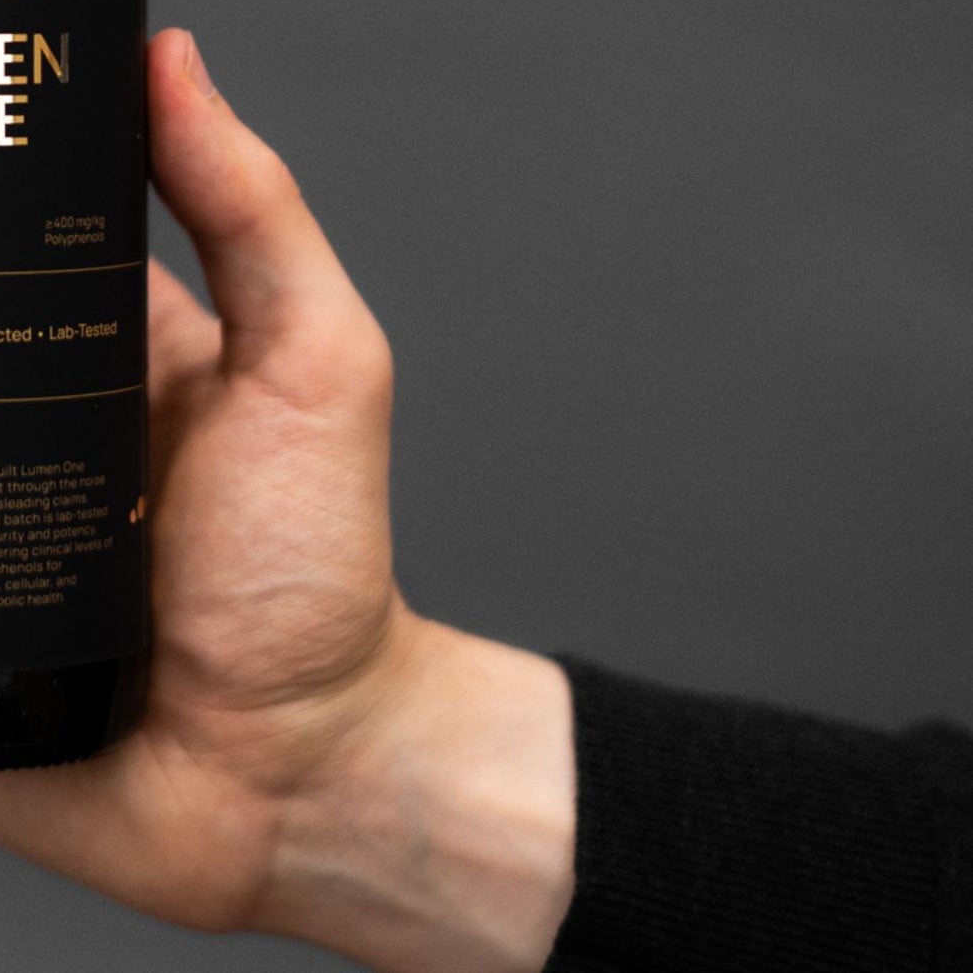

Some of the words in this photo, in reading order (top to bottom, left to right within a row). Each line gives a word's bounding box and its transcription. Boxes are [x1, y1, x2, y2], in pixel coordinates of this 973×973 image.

[76, 215, 106, 230] mg/kg
[45, 231, 105, 247] Polyphenols
[49, 321, 117, 341] Lab-Tested
[21, 463, 60, 476] Lumen
[63, 461, 84, 473] One
[7, 481, 56, 494] through
[59, 478, 76, 489] the
[80, 475, 105, 487] noise
[4, 512, 40, 525] batch
[43, 512, 52, 522] is
[28, 528, 50, 540] and
[32, 543, 71, 556] clinical
[75, 539, 102, 552] levels
[46, 560, 62, 571] for
[56, 575, 77, 586] and
